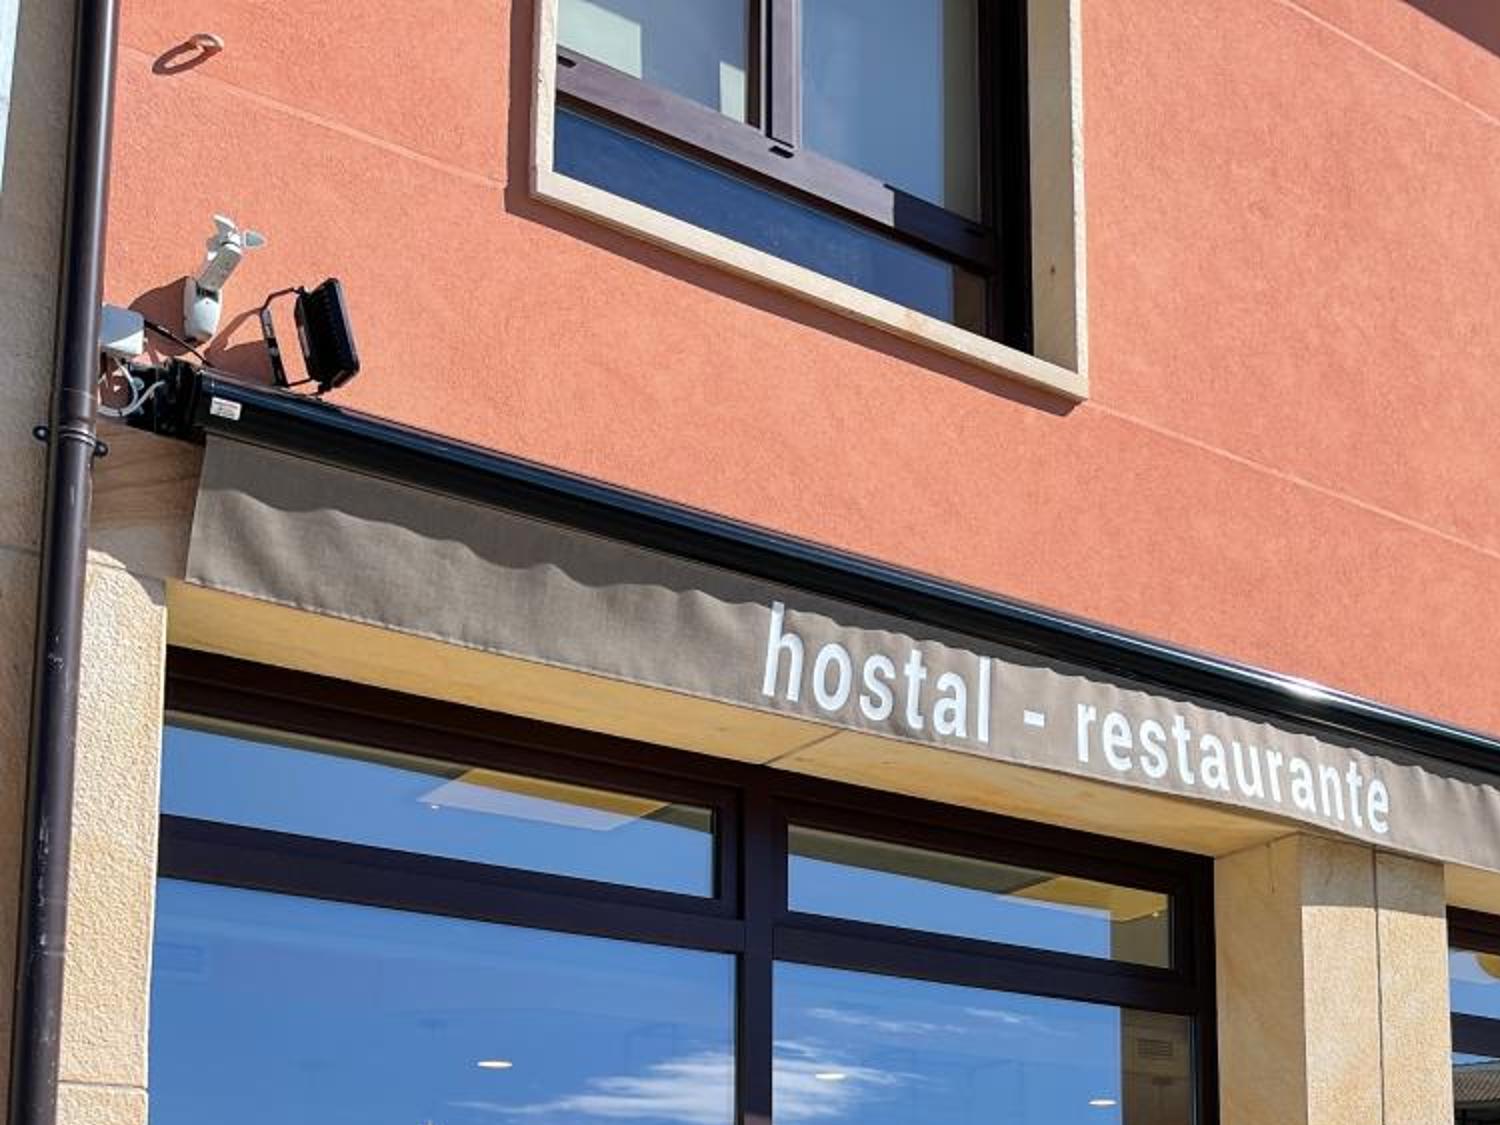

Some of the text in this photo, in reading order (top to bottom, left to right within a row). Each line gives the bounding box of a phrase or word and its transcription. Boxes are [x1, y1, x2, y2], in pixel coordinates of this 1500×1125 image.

[762, 602, 1391, 834] hostal - restaurante
